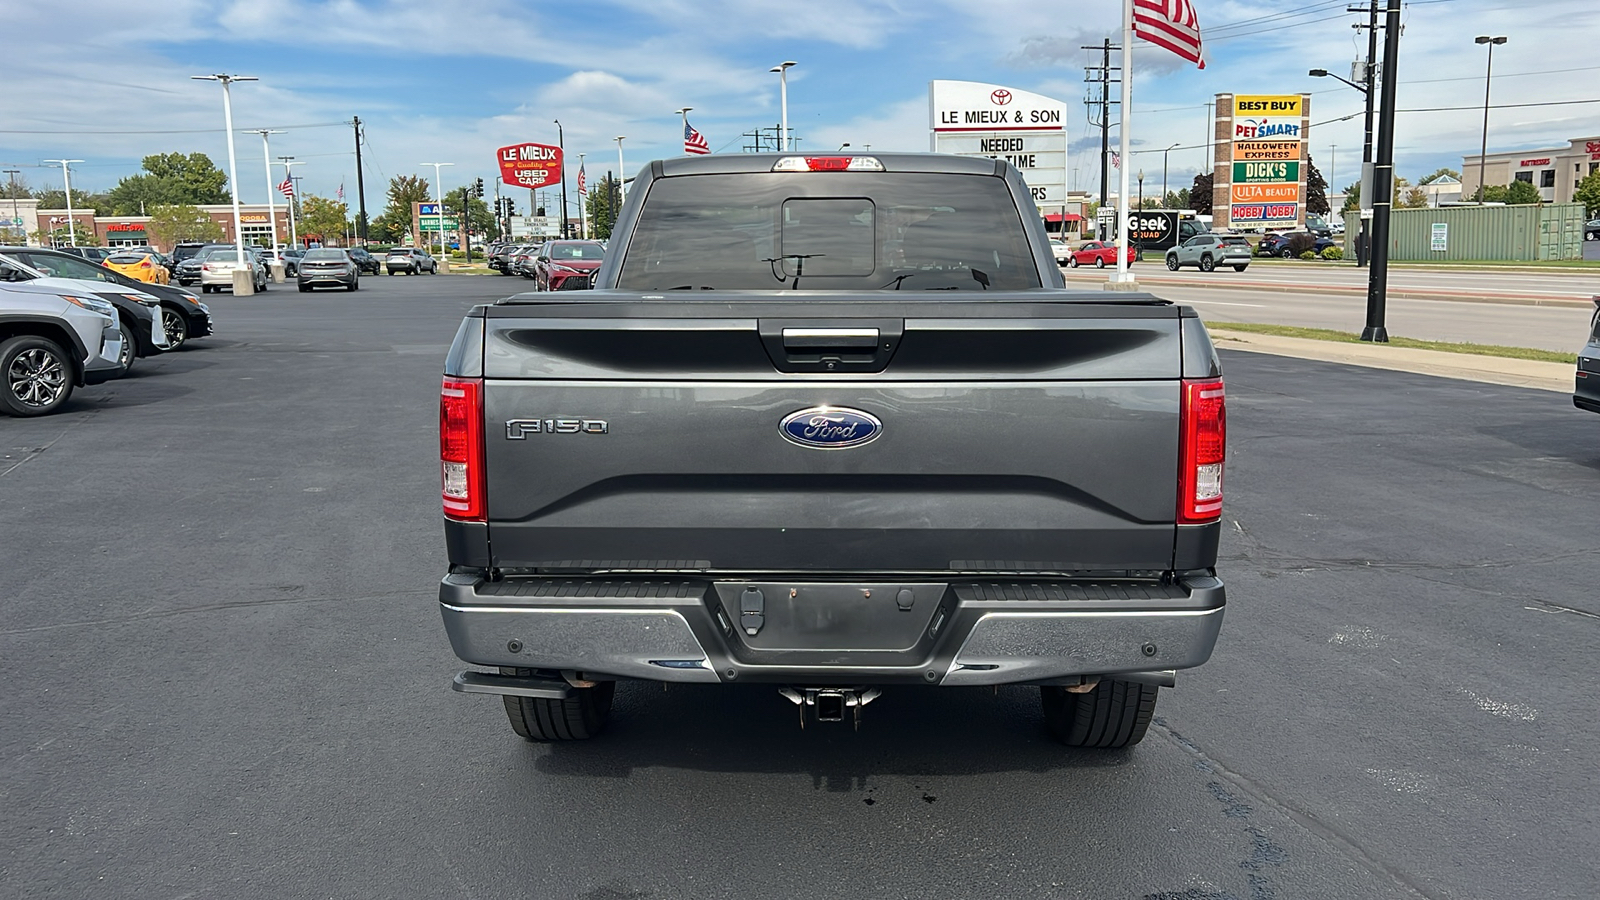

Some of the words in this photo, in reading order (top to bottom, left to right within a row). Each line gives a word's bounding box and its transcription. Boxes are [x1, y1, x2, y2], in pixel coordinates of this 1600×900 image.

[1239, 102, 1268, 110] BEST
[1271, 102, 1297, 110] BUY
[942, 111, 958, 124] LE
[965, 110, 1008, 124] MIEUX
[1014, 110, 1024, 123] &
[1030, 110, 1060, 123] SON
[1236, 124, 1299, 138] PETSMART
[980, 138, 1023, 152] NEEDED
[503, 149, 517, 161] LE
[519, 145, 556, 161] MIEUX
[1246, 163, 1287, 178] DICK'S
[518, 177, 546, 186] CARS
[1237, 186, 1263, 197] ULTA
[1265, 188, 1297, 196] BEAUTY
[1232, 206, 1263, 218] HOBBY
[1267, 205, 1295, 217] LOBBY
[1128, 216, 1167, 231] Geek
[1132, 231, 1160, 239] SQUAD
[804, 415, 857, 440] Ford
